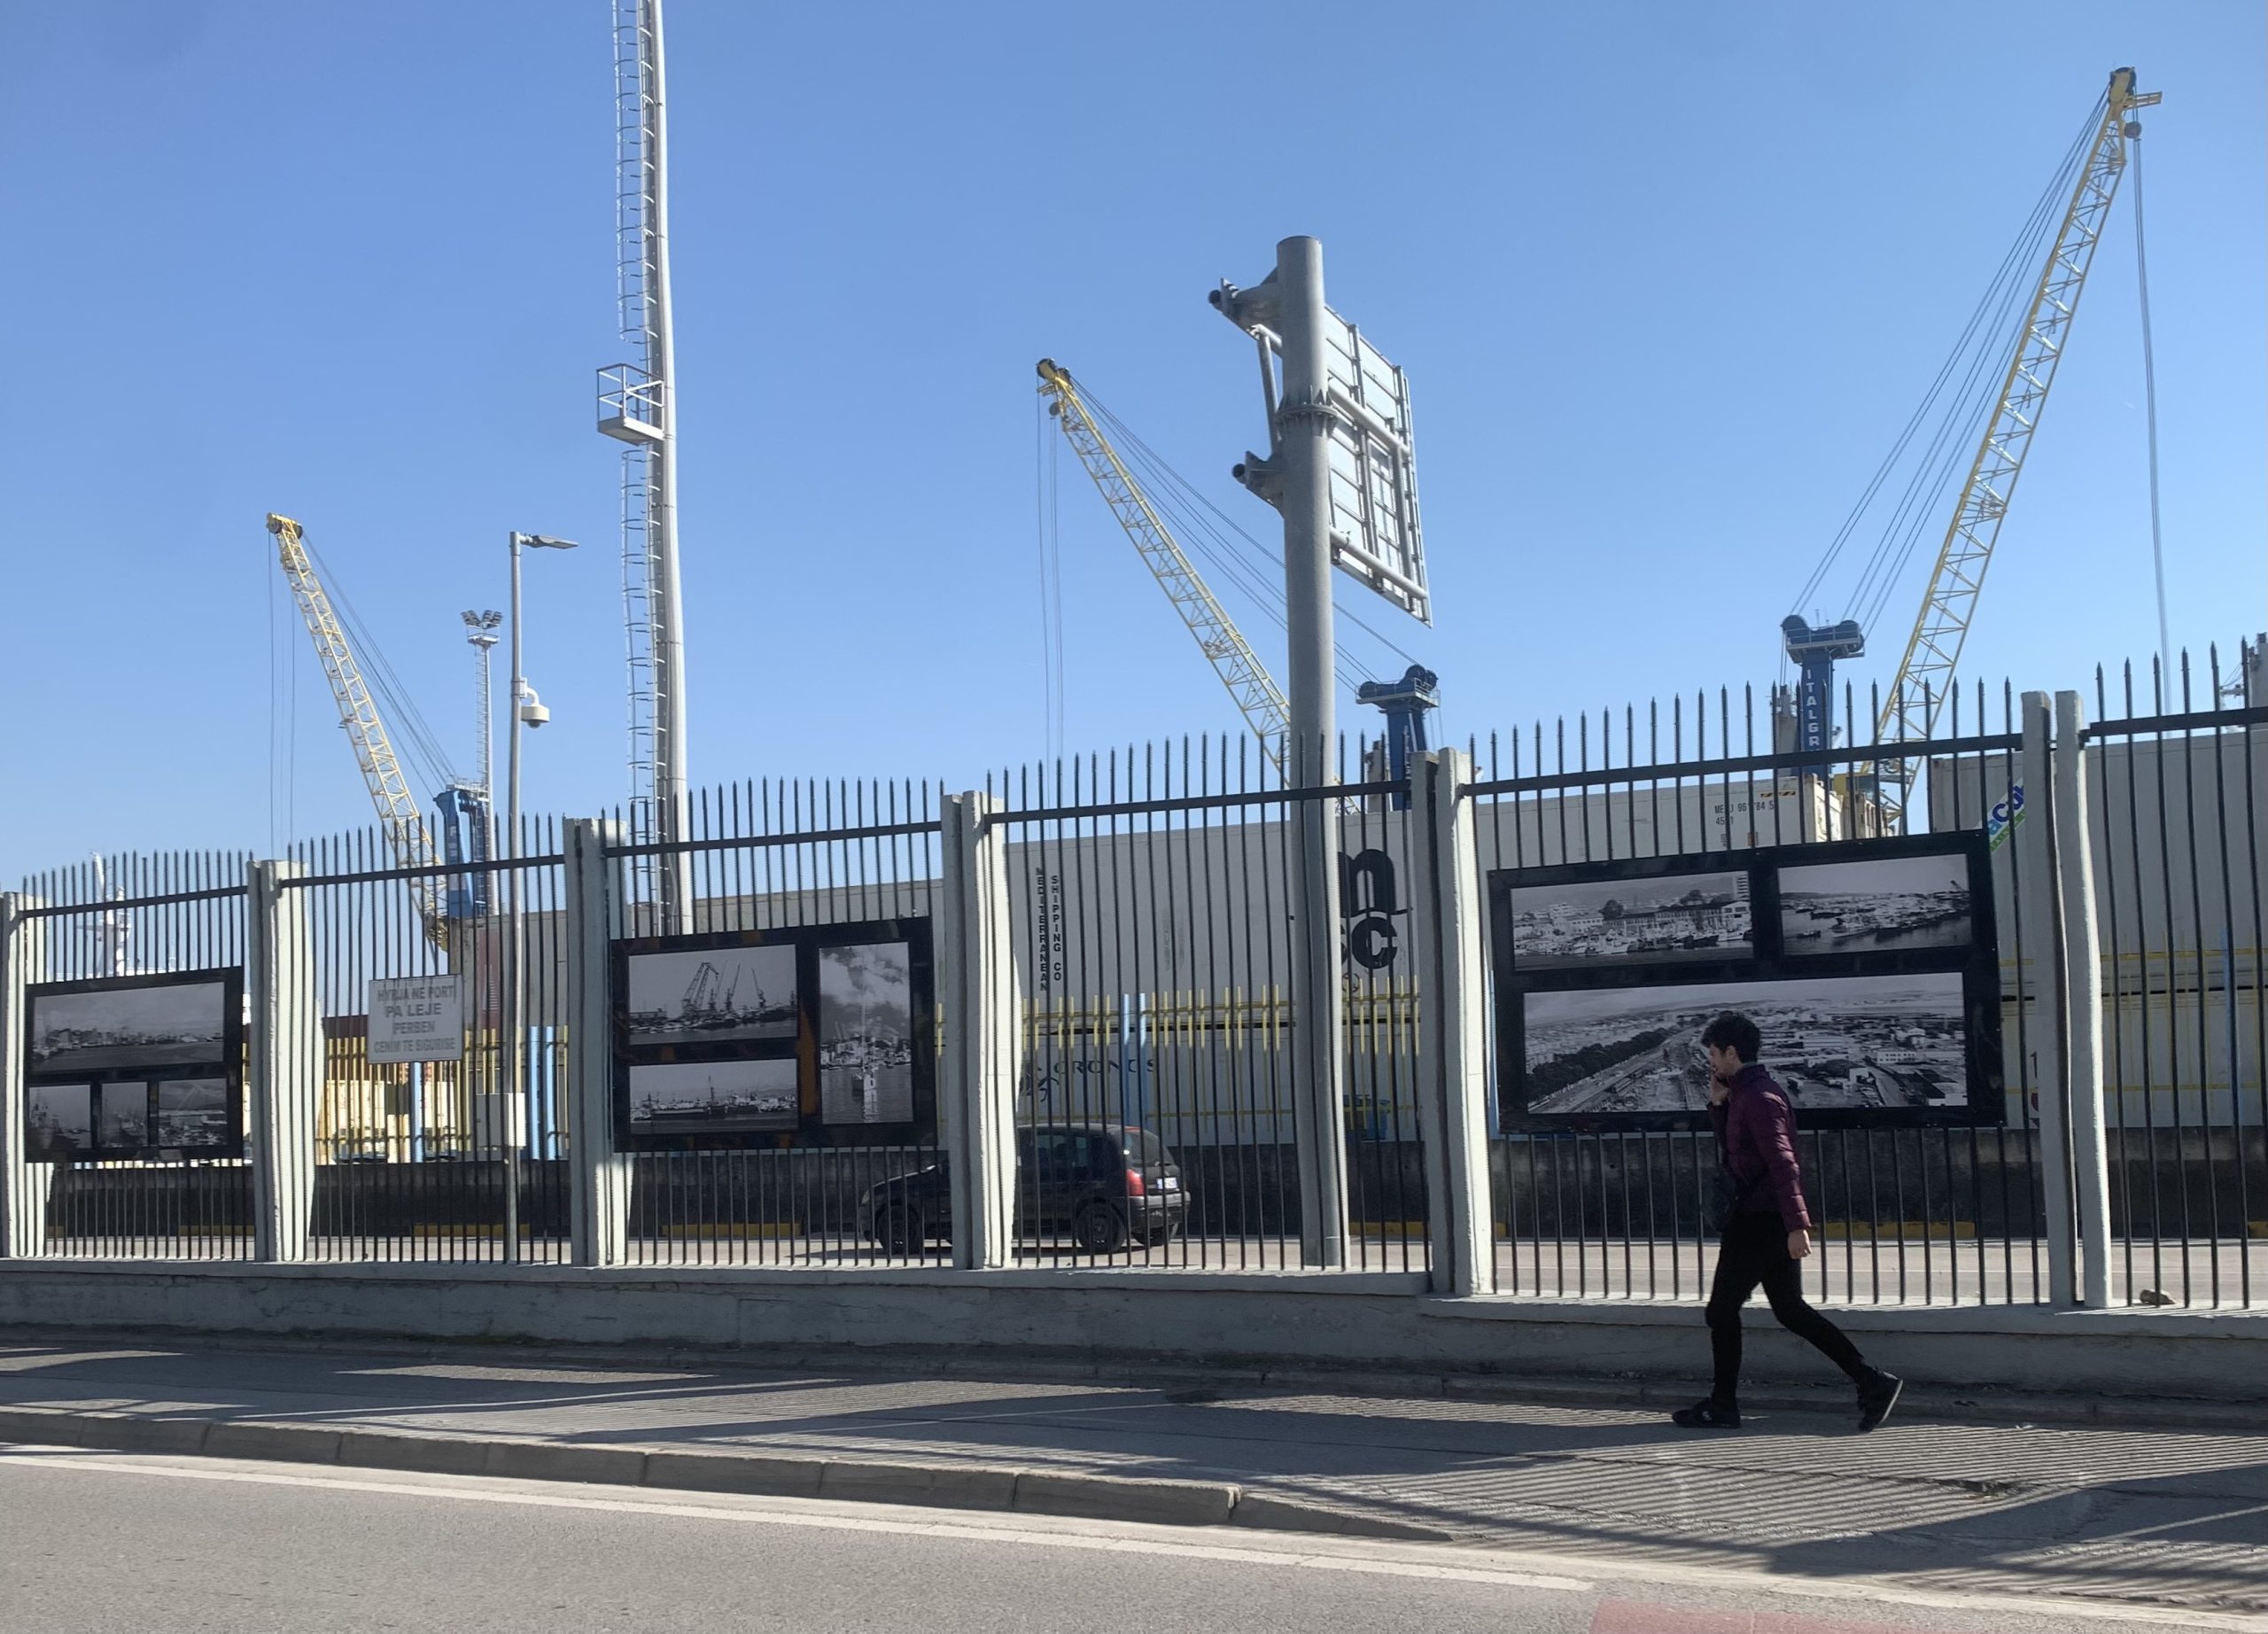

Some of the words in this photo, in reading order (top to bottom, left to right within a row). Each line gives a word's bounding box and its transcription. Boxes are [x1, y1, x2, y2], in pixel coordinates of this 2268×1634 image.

[1806, 669, 1821, 751] ITALGR
[1715, 816, 1734, 826] 451
[1052, 875, 1061, 953] SHIPPING
[1053, 962, 1062, 981] CO
[428, 984, 454, 1000] PORT
[385, 1005, 402, 1018] PA
[408, 1002, 441, 1016] LEJE
[402, 1039, 414, 1052] TE
